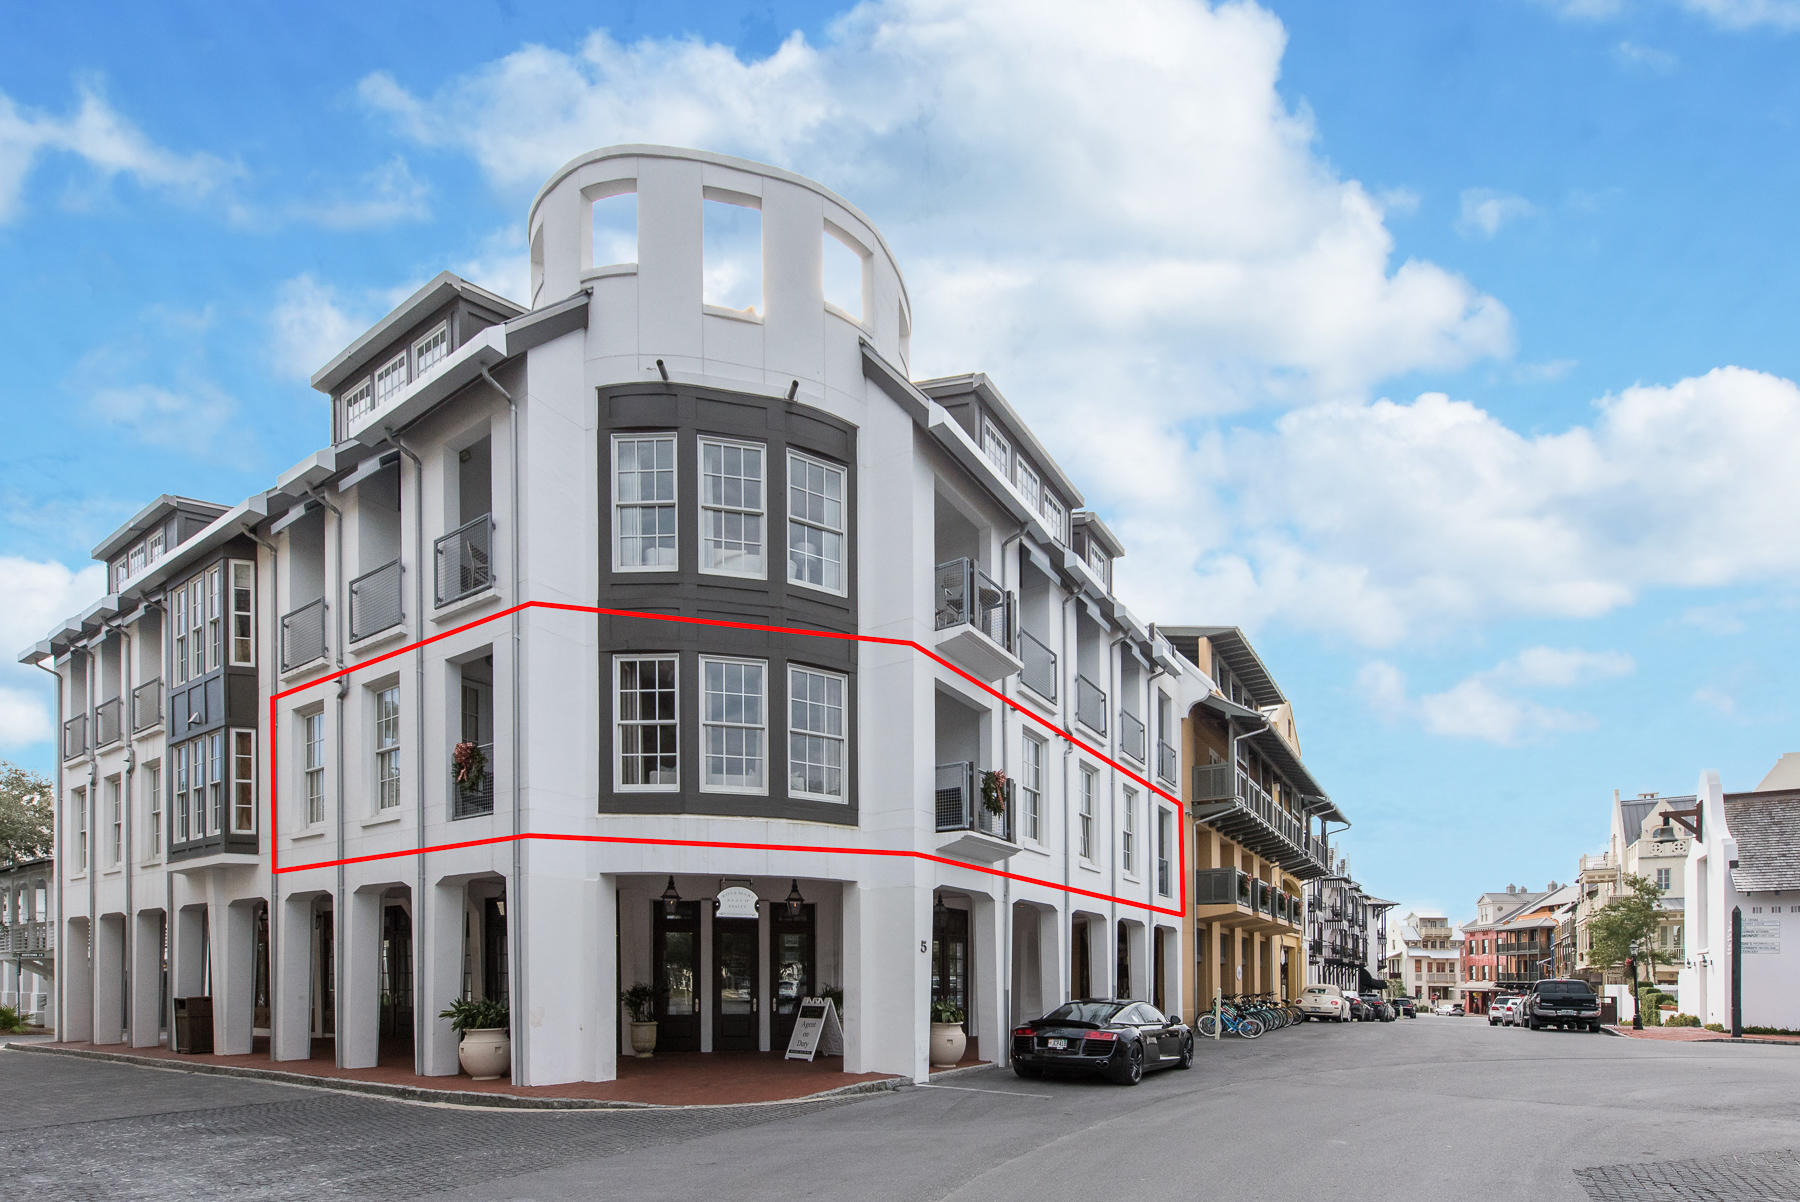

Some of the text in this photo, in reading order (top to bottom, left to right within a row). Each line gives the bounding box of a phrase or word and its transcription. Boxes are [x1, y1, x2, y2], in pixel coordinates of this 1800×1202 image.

[920, 940, 928, 953] 5
[801, 1020, 817, 1028] Agent
[796, 1040, 810, 1048] Duty
